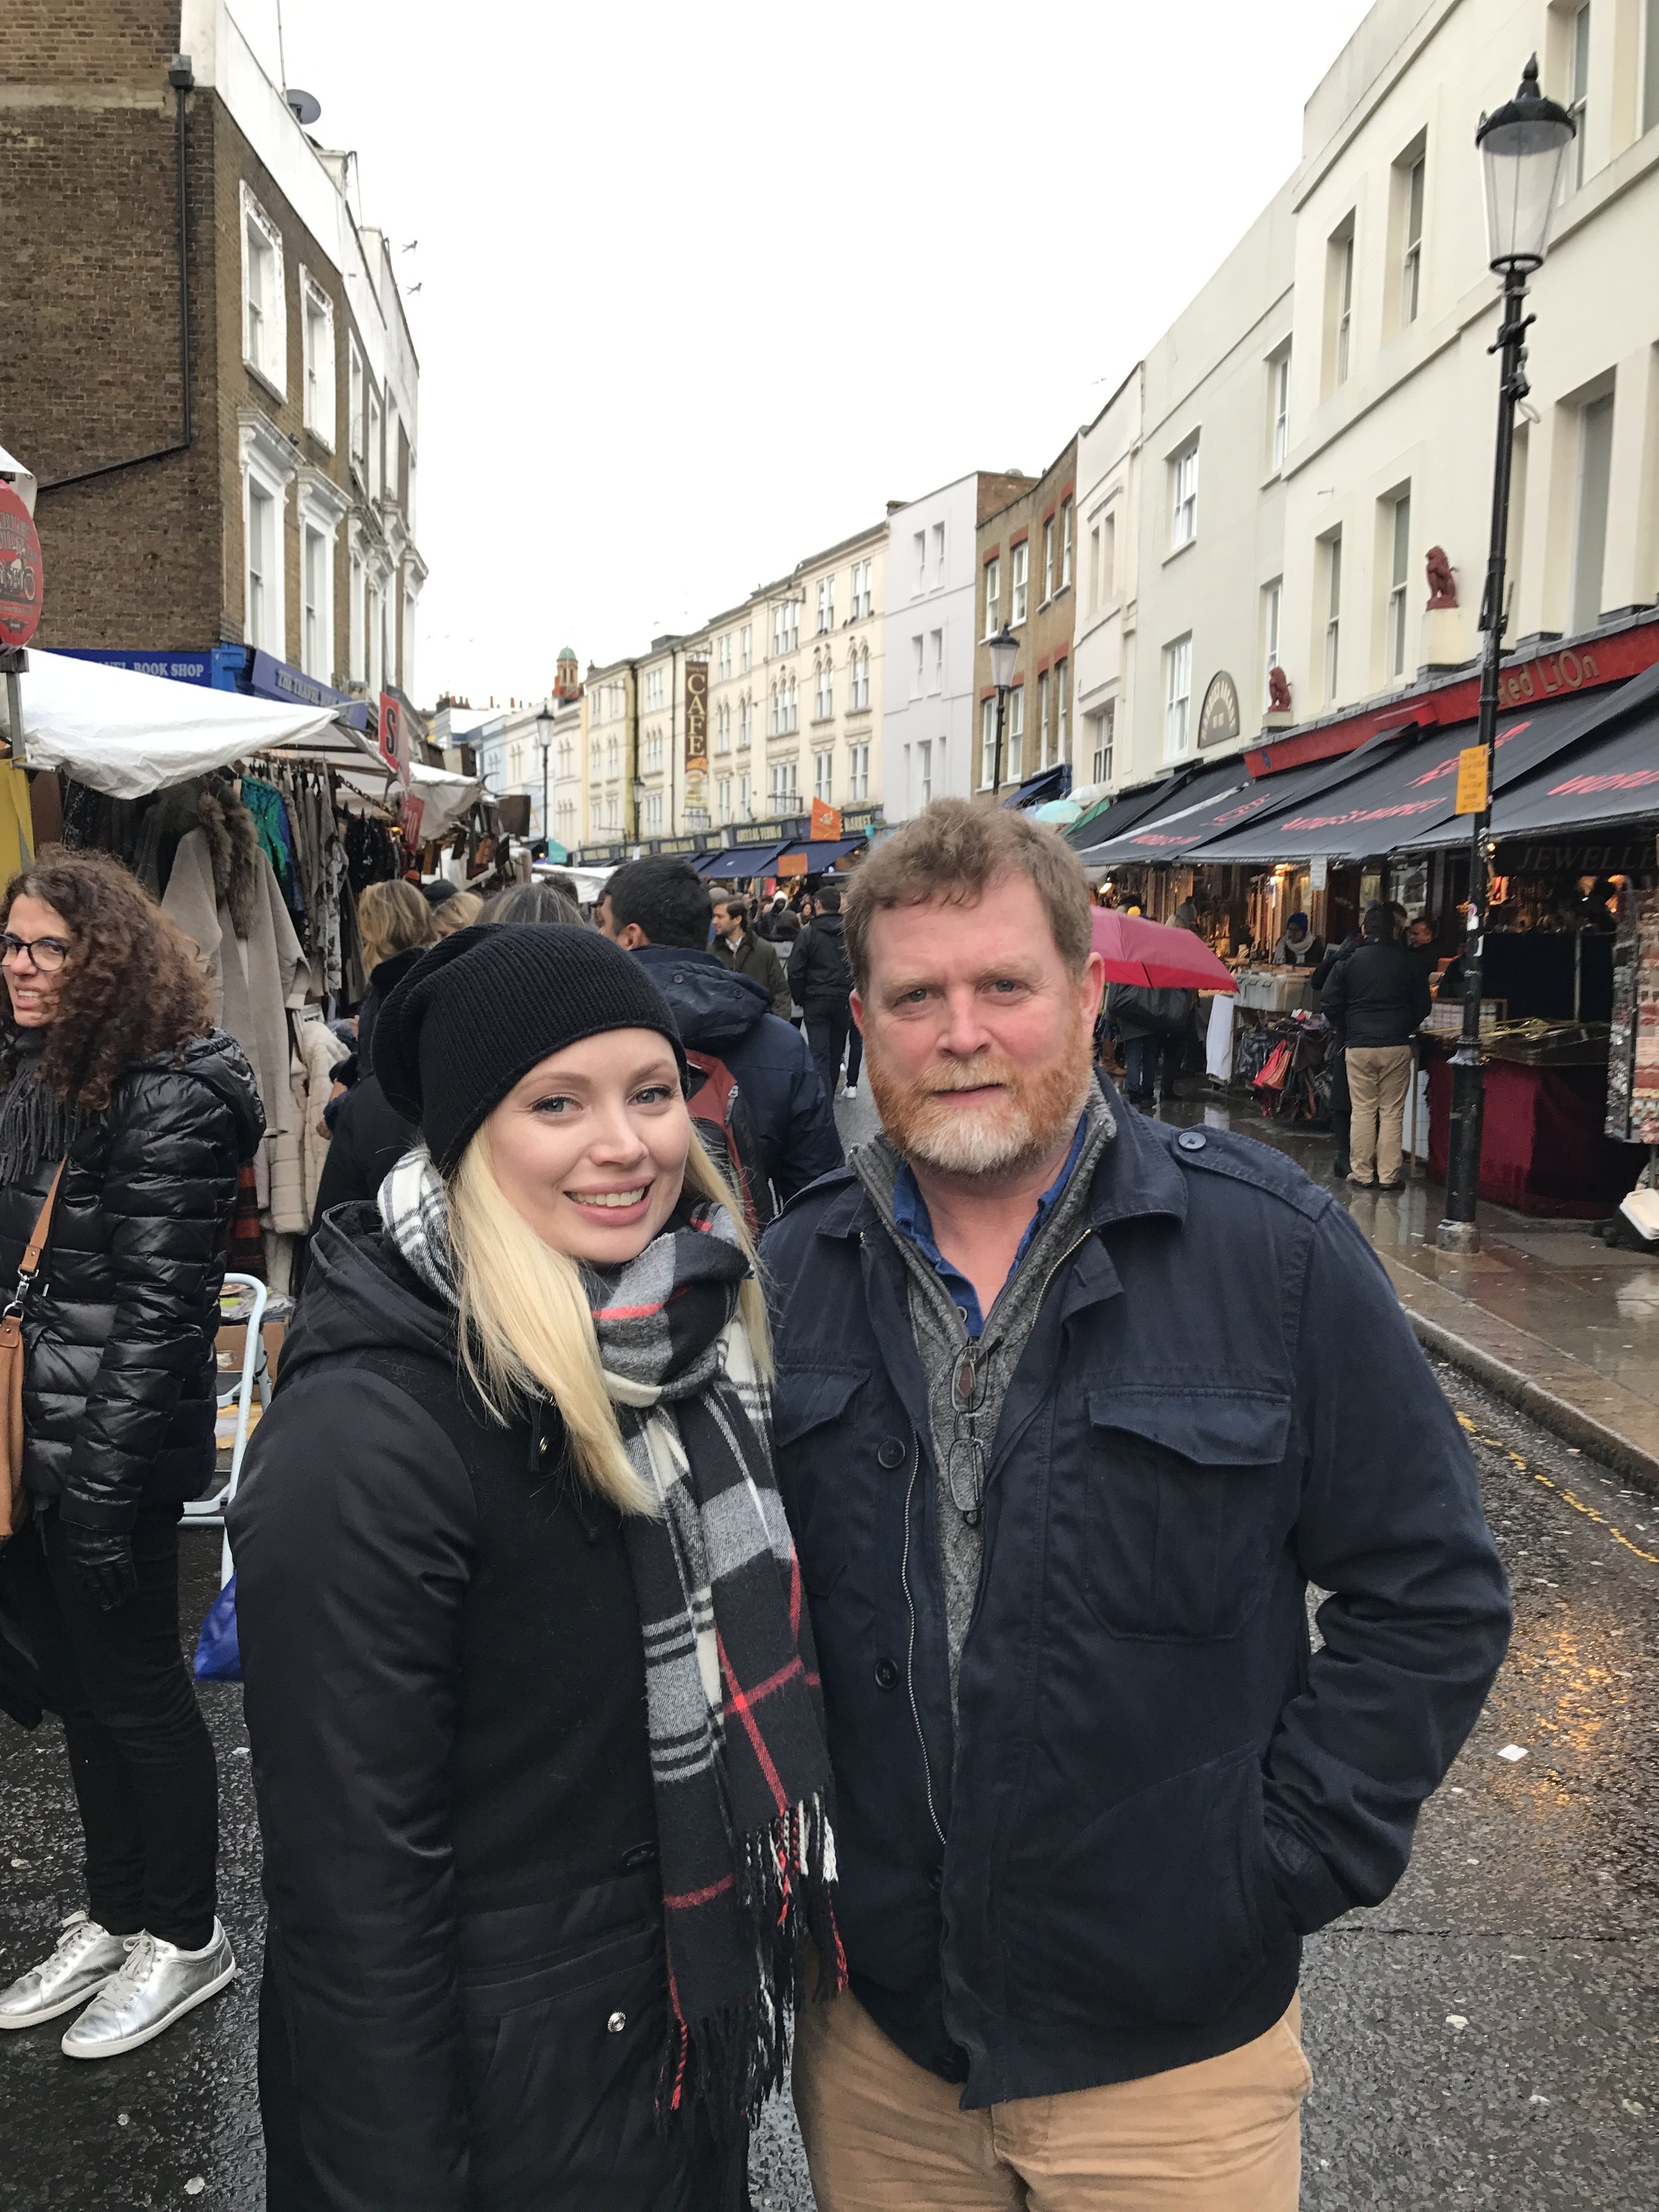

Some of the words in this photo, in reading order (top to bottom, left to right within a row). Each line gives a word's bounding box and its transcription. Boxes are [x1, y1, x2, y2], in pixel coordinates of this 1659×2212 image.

[133, 662, 169, 676] BOOK
[171, 664, 204, 677] SHOP
[277, 669, 293, 691] THE
[686, 673, 706, 756] CAFE
